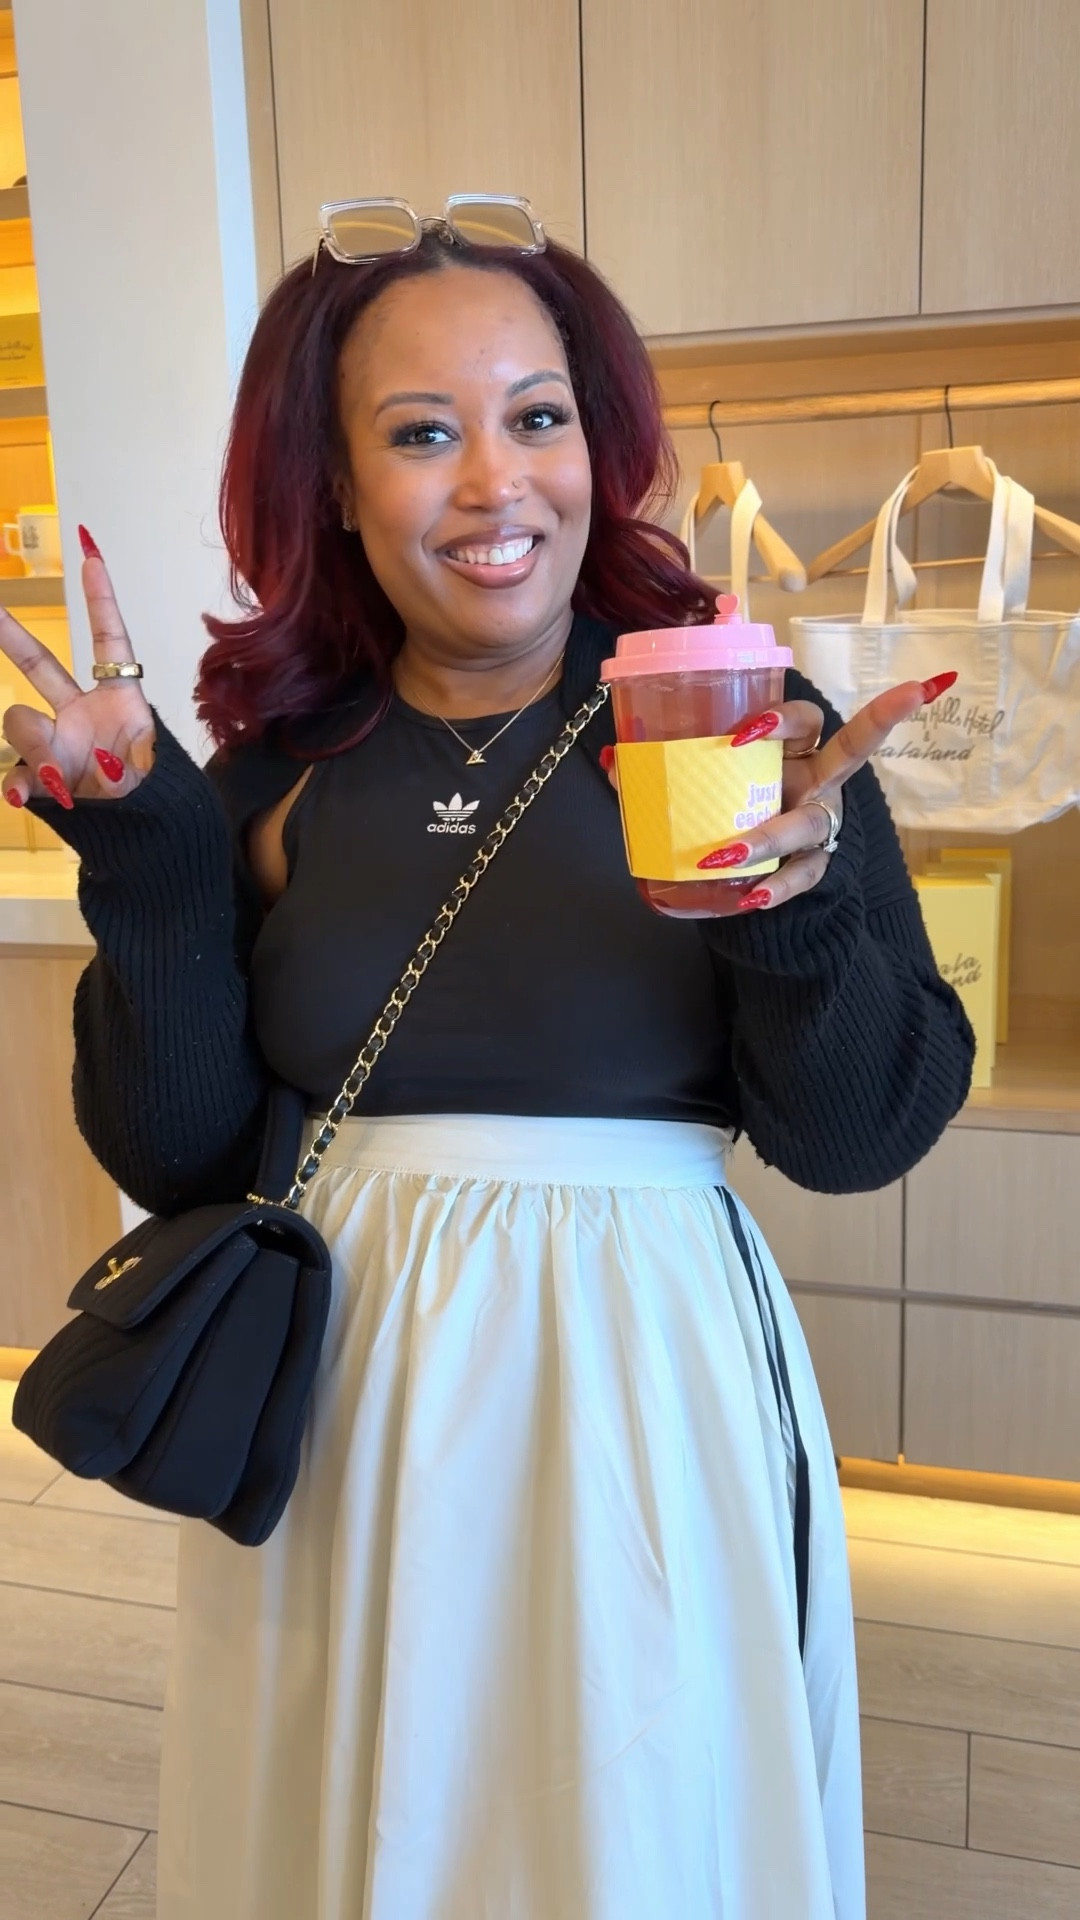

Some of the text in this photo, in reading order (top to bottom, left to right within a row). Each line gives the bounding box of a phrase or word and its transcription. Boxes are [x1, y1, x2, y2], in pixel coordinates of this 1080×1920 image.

[930, 697, 961, 730] Hills
[963, 706, 1005, 739] Hotel
[747, 783, 777, 808] just
[426, 821, 477, 835] adidas
